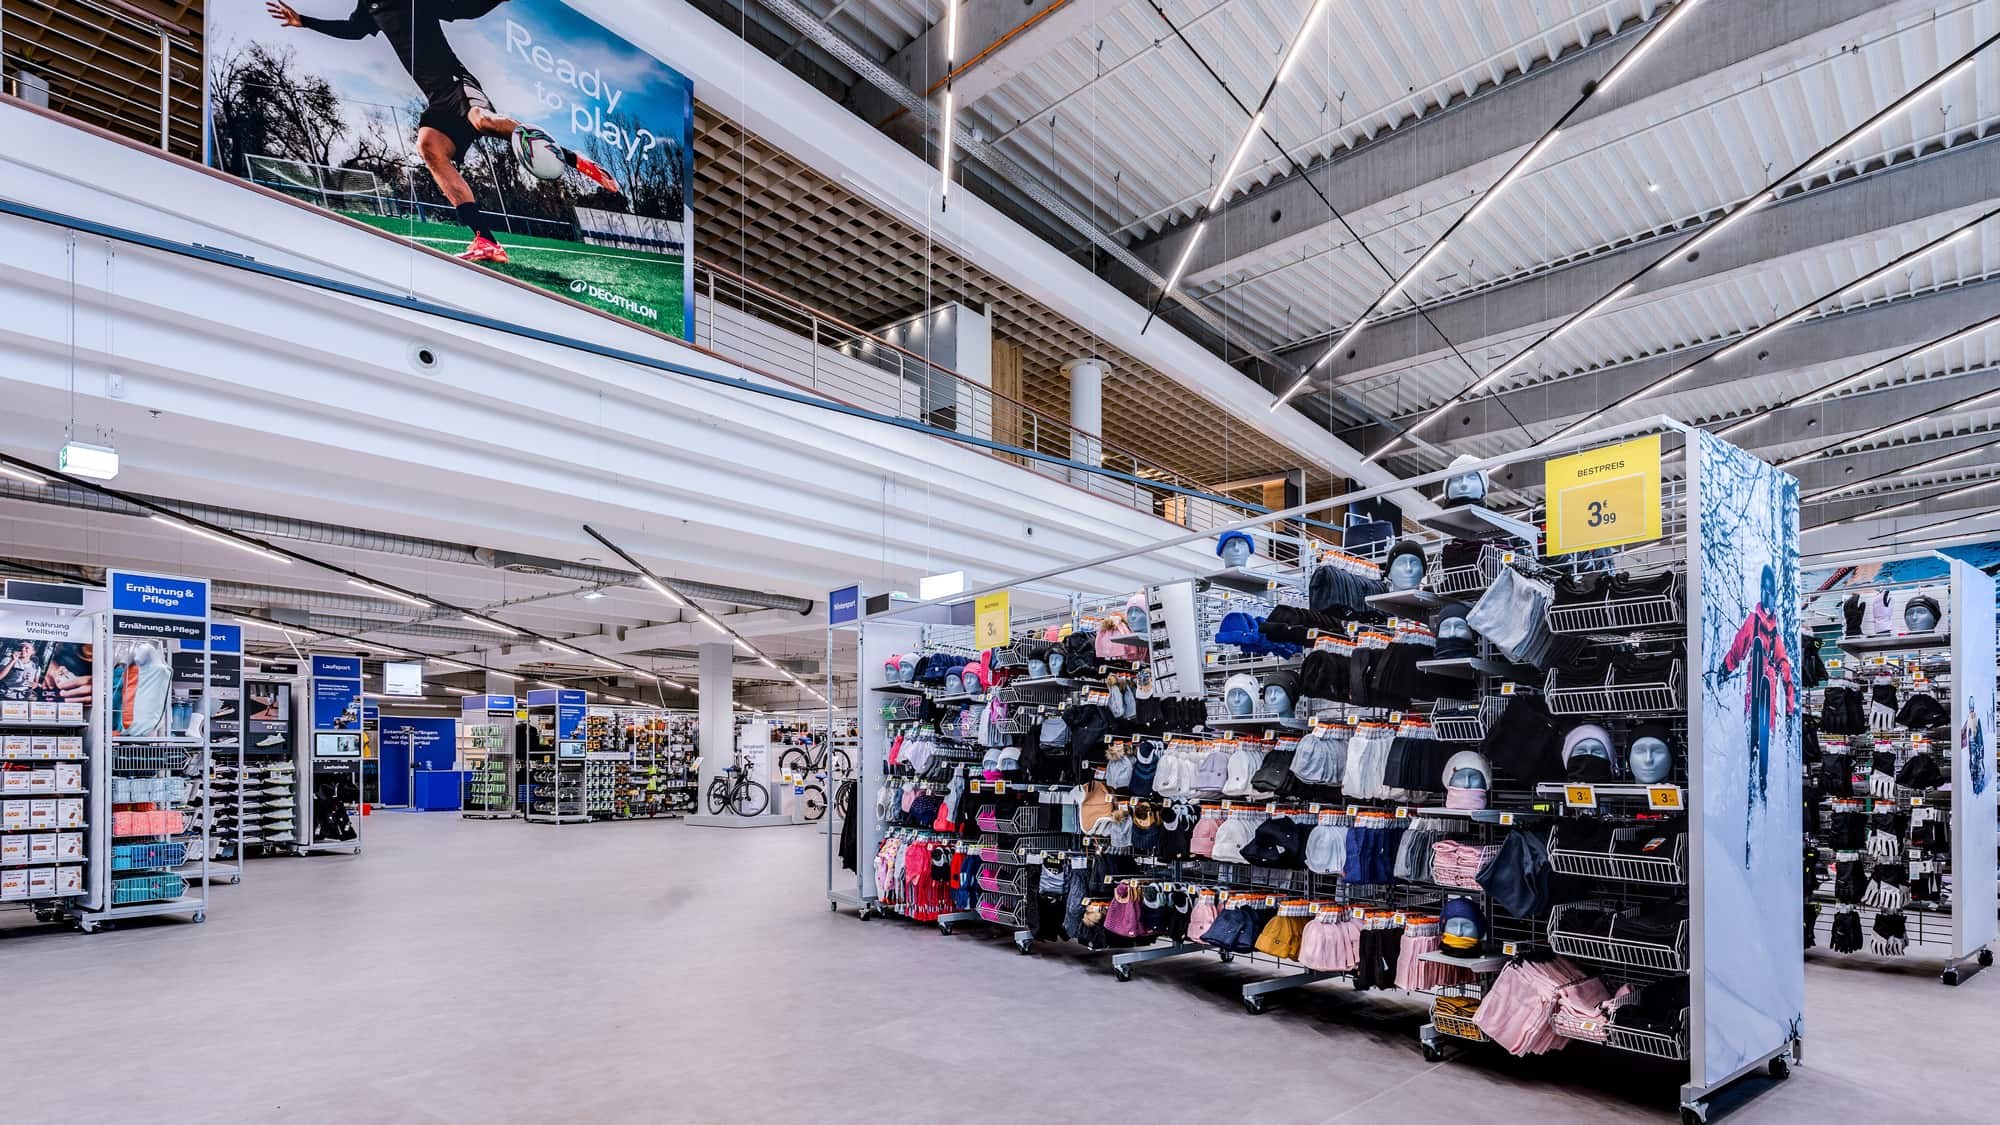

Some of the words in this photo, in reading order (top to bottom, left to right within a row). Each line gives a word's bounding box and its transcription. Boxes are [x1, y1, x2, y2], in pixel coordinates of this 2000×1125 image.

[506, 18, 623, 114] Ready
[534, 80, 562, 111] to
[570, 103, 656, 162] play?
[589, 284, 658, 321] DECATHLON
[1577, 461, 1625, 478] BESTPREIS
[126, 582, 184, 599] Ernährung
[185, 589, 195, 599] &
[142, 594, 180, 607] Pflege
[25, 619, 70, 631] Ernährung
[26, 627, 69, 638] Wellbeing
[118, 621, 164, 634] Ernährung
[164, 625, 172, 633] &
[172, 625, 200, 636] Pflege
[322, 663, 351, 671] Laufsport
